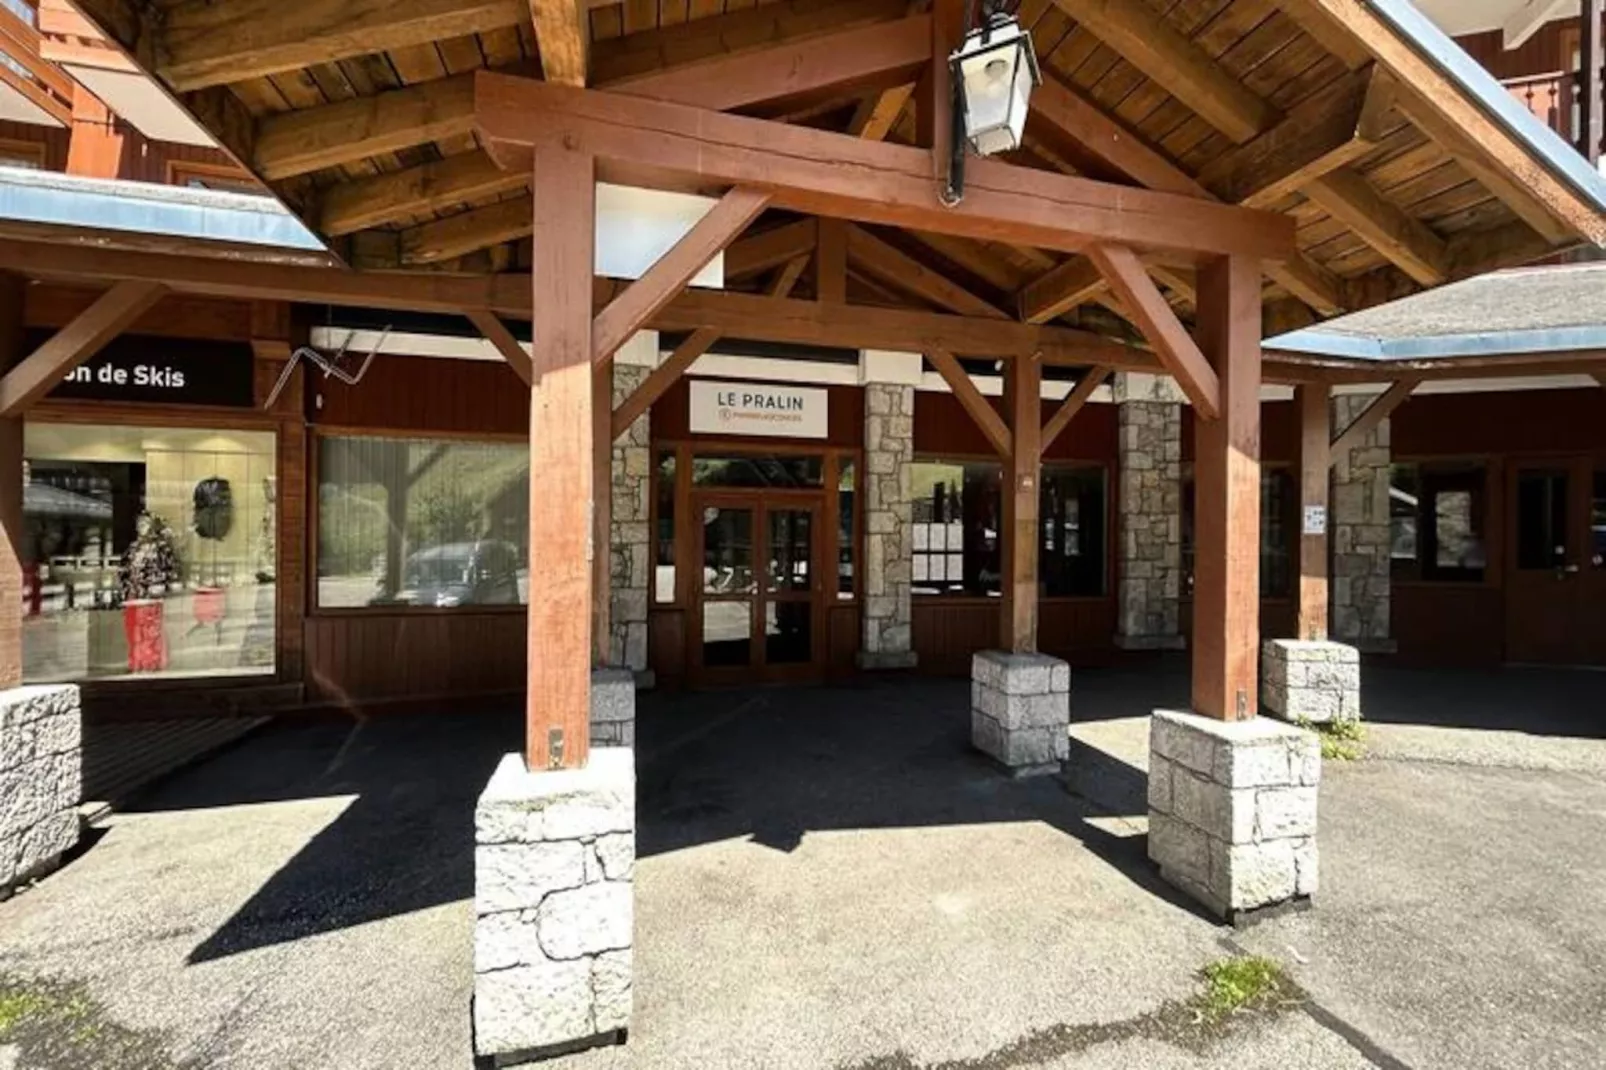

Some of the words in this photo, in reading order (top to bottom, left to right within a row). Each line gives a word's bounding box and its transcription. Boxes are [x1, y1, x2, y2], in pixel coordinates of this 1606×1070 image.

[97, 362, 128, 385] de
[133, 364, 186, 388] Skis
[717, 391, 736, 407] LE
[742, 394, 804, 411] PRALIN
